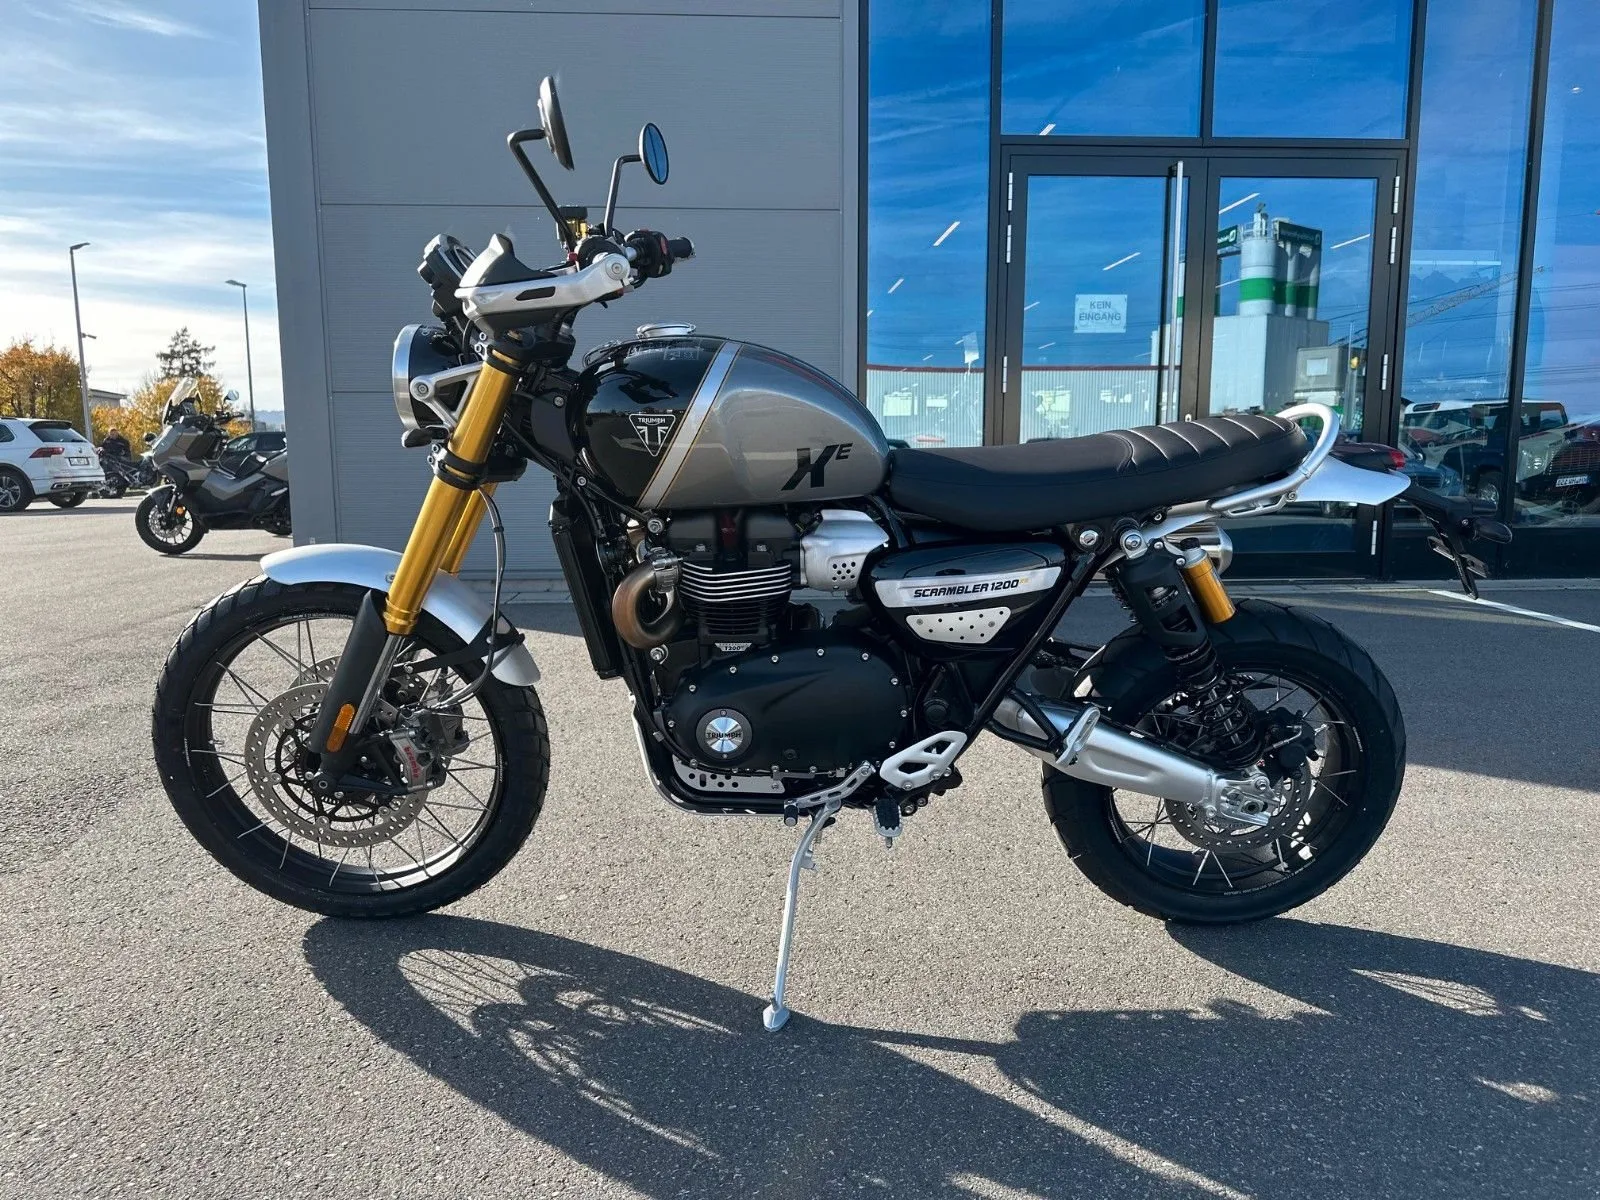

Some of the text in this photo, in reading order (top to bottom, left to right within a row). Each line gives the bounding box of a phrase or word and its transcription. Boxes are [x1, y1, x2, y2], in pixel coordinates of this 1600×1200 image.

[1090, 301, 1111, 309] KEIN
[1079, 313, 1121, 321] EINGANG
[914, 583, 989, 597] SCRAMBLER
[990, 579, 1019, 591] 1200
